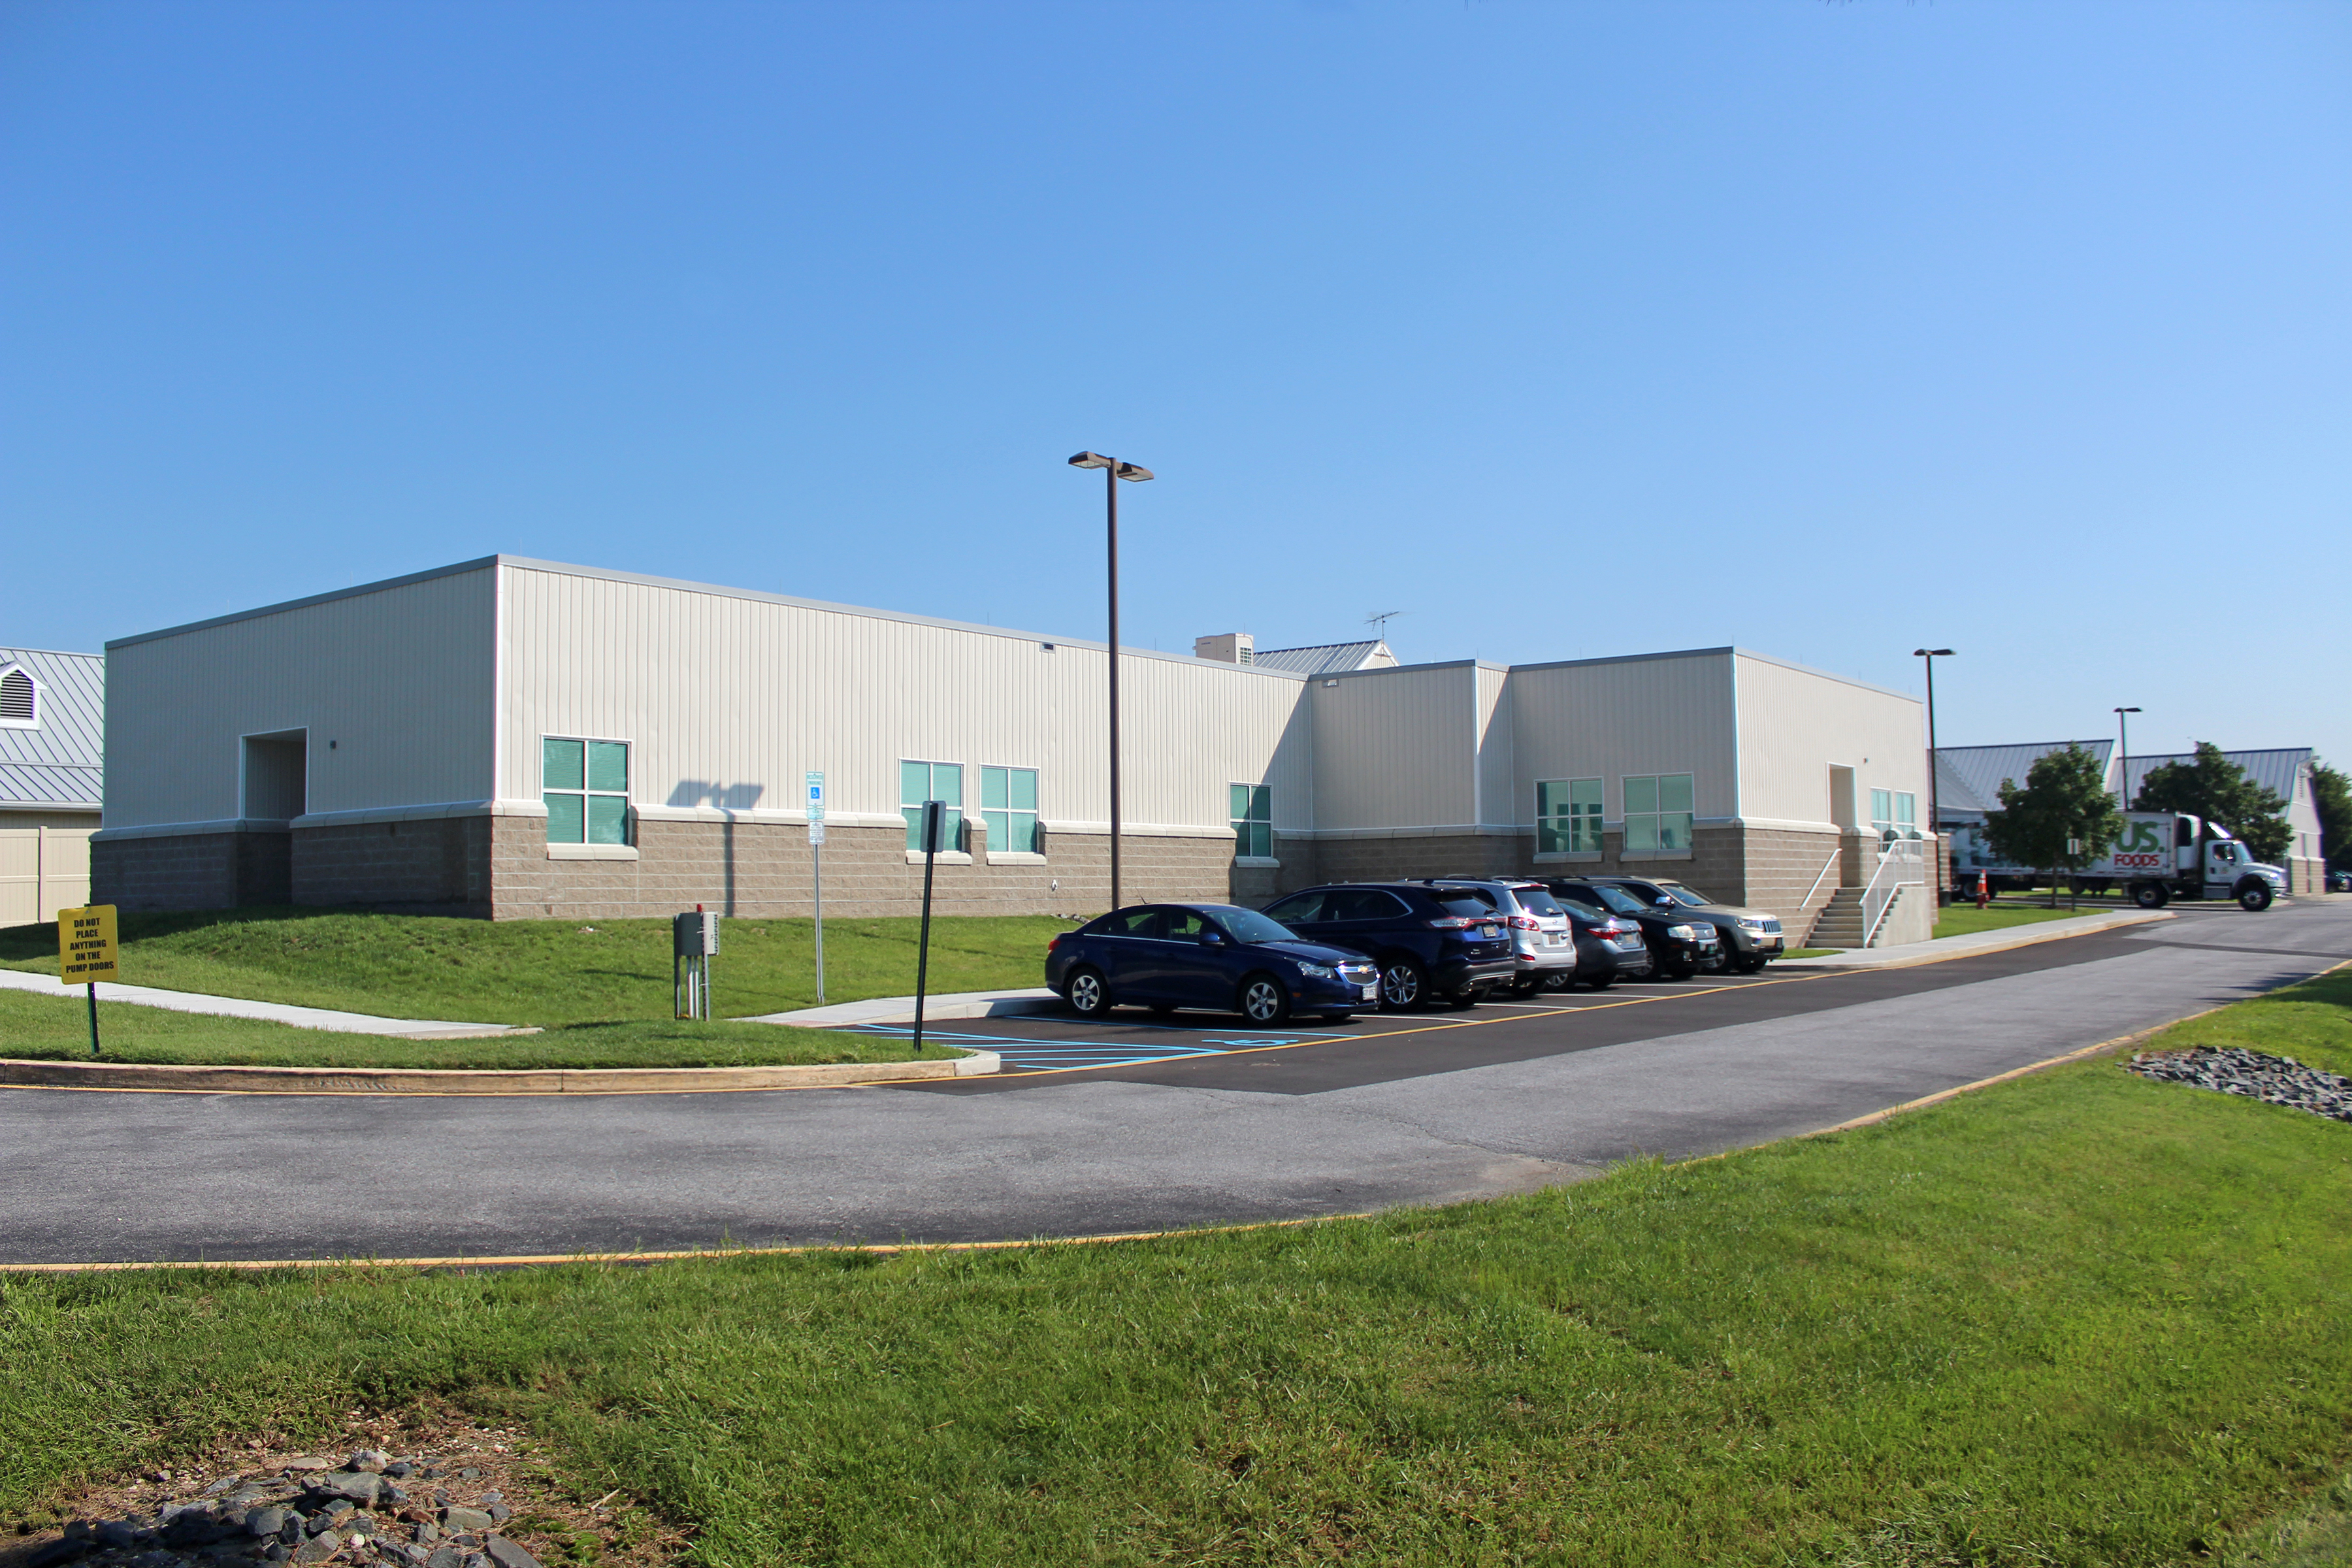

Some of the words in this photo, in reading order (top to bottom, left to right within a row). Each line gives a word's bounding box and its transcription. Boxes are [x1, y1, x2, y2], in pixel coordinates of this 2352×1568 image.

[2114, 854, 2159, 866] FOODS
[86, 917, 100, 926] NOT
[76, 929, 98, 938] PLACE
[70, 939, 106, 950] ANYTHING
[76, 953, 86, 961] ON
[66, 964, 88, 973] PUMP
[89, 961, 114, 971] DOORS
